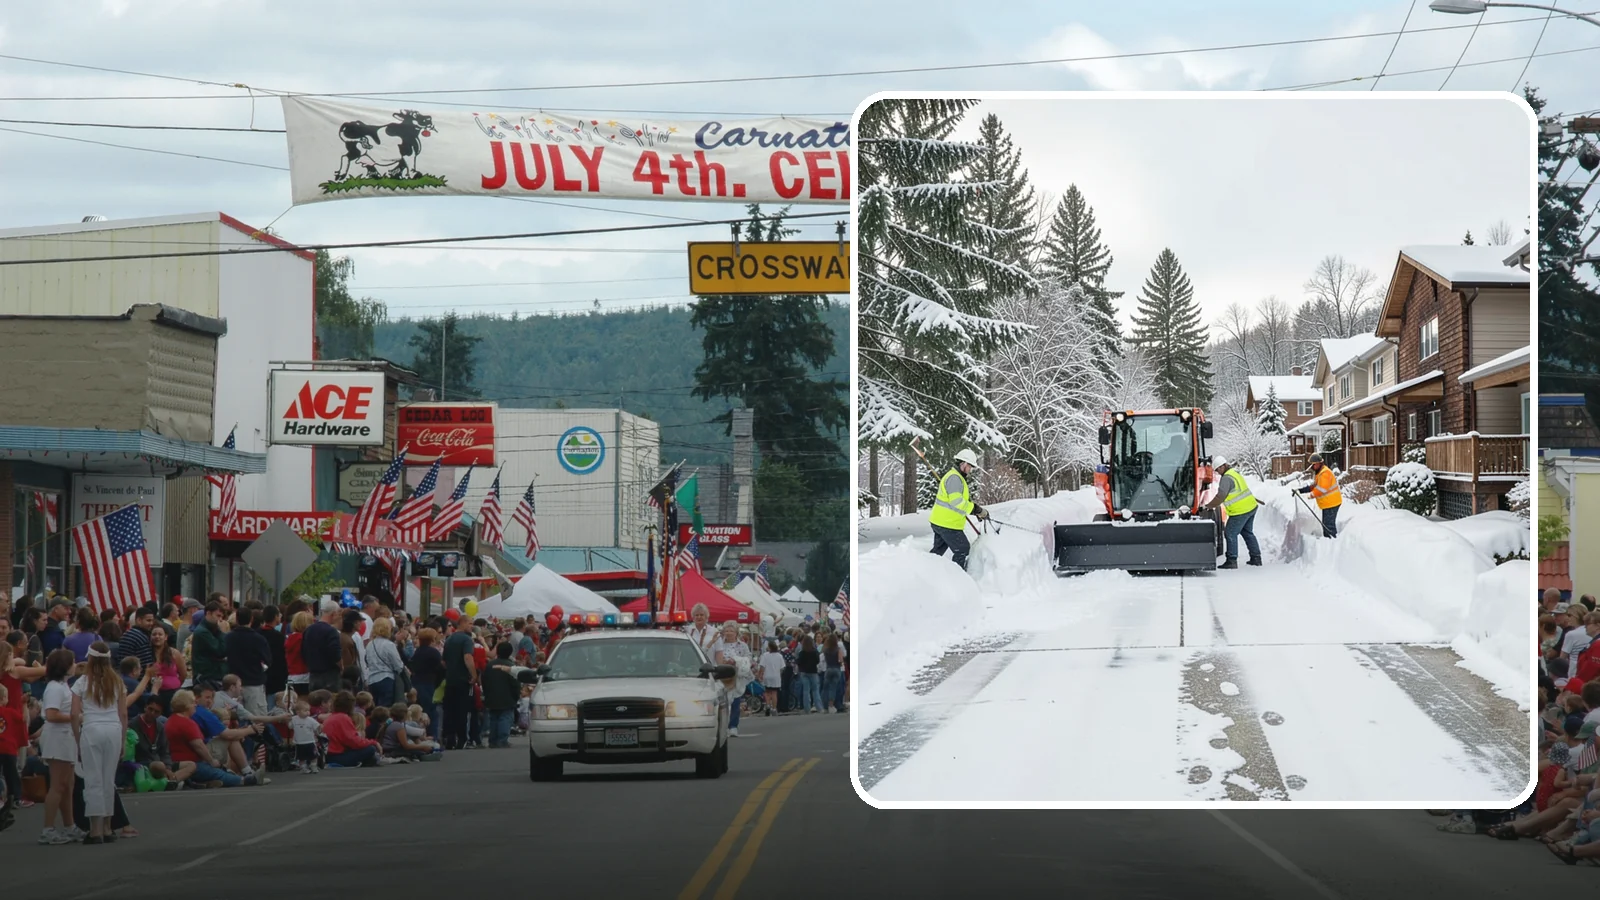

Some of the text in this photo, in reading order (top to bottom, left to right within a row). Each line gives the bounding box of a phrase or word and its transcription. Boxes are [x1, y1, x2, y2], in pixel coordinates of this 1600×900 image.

[481, 141, 605, 193] JULY
[632, 150, 747, 197] 4th.
[697, 254, 850, 280] CROSSWA
[282, 380, 373, 420] ACE
[405, 409, 453, 422] CEDAR
[283, 421, 371, 436] Hardware
[416, 428, 477, 447] Coca-Cola
[96, 485, 124, 495] Vincent
[126, 485, 135, 494] de
[137, 486, 155, 495] Paul
[688, 527, 741, 535] CRNATION
[699, 535, 730, 543] GLASS
